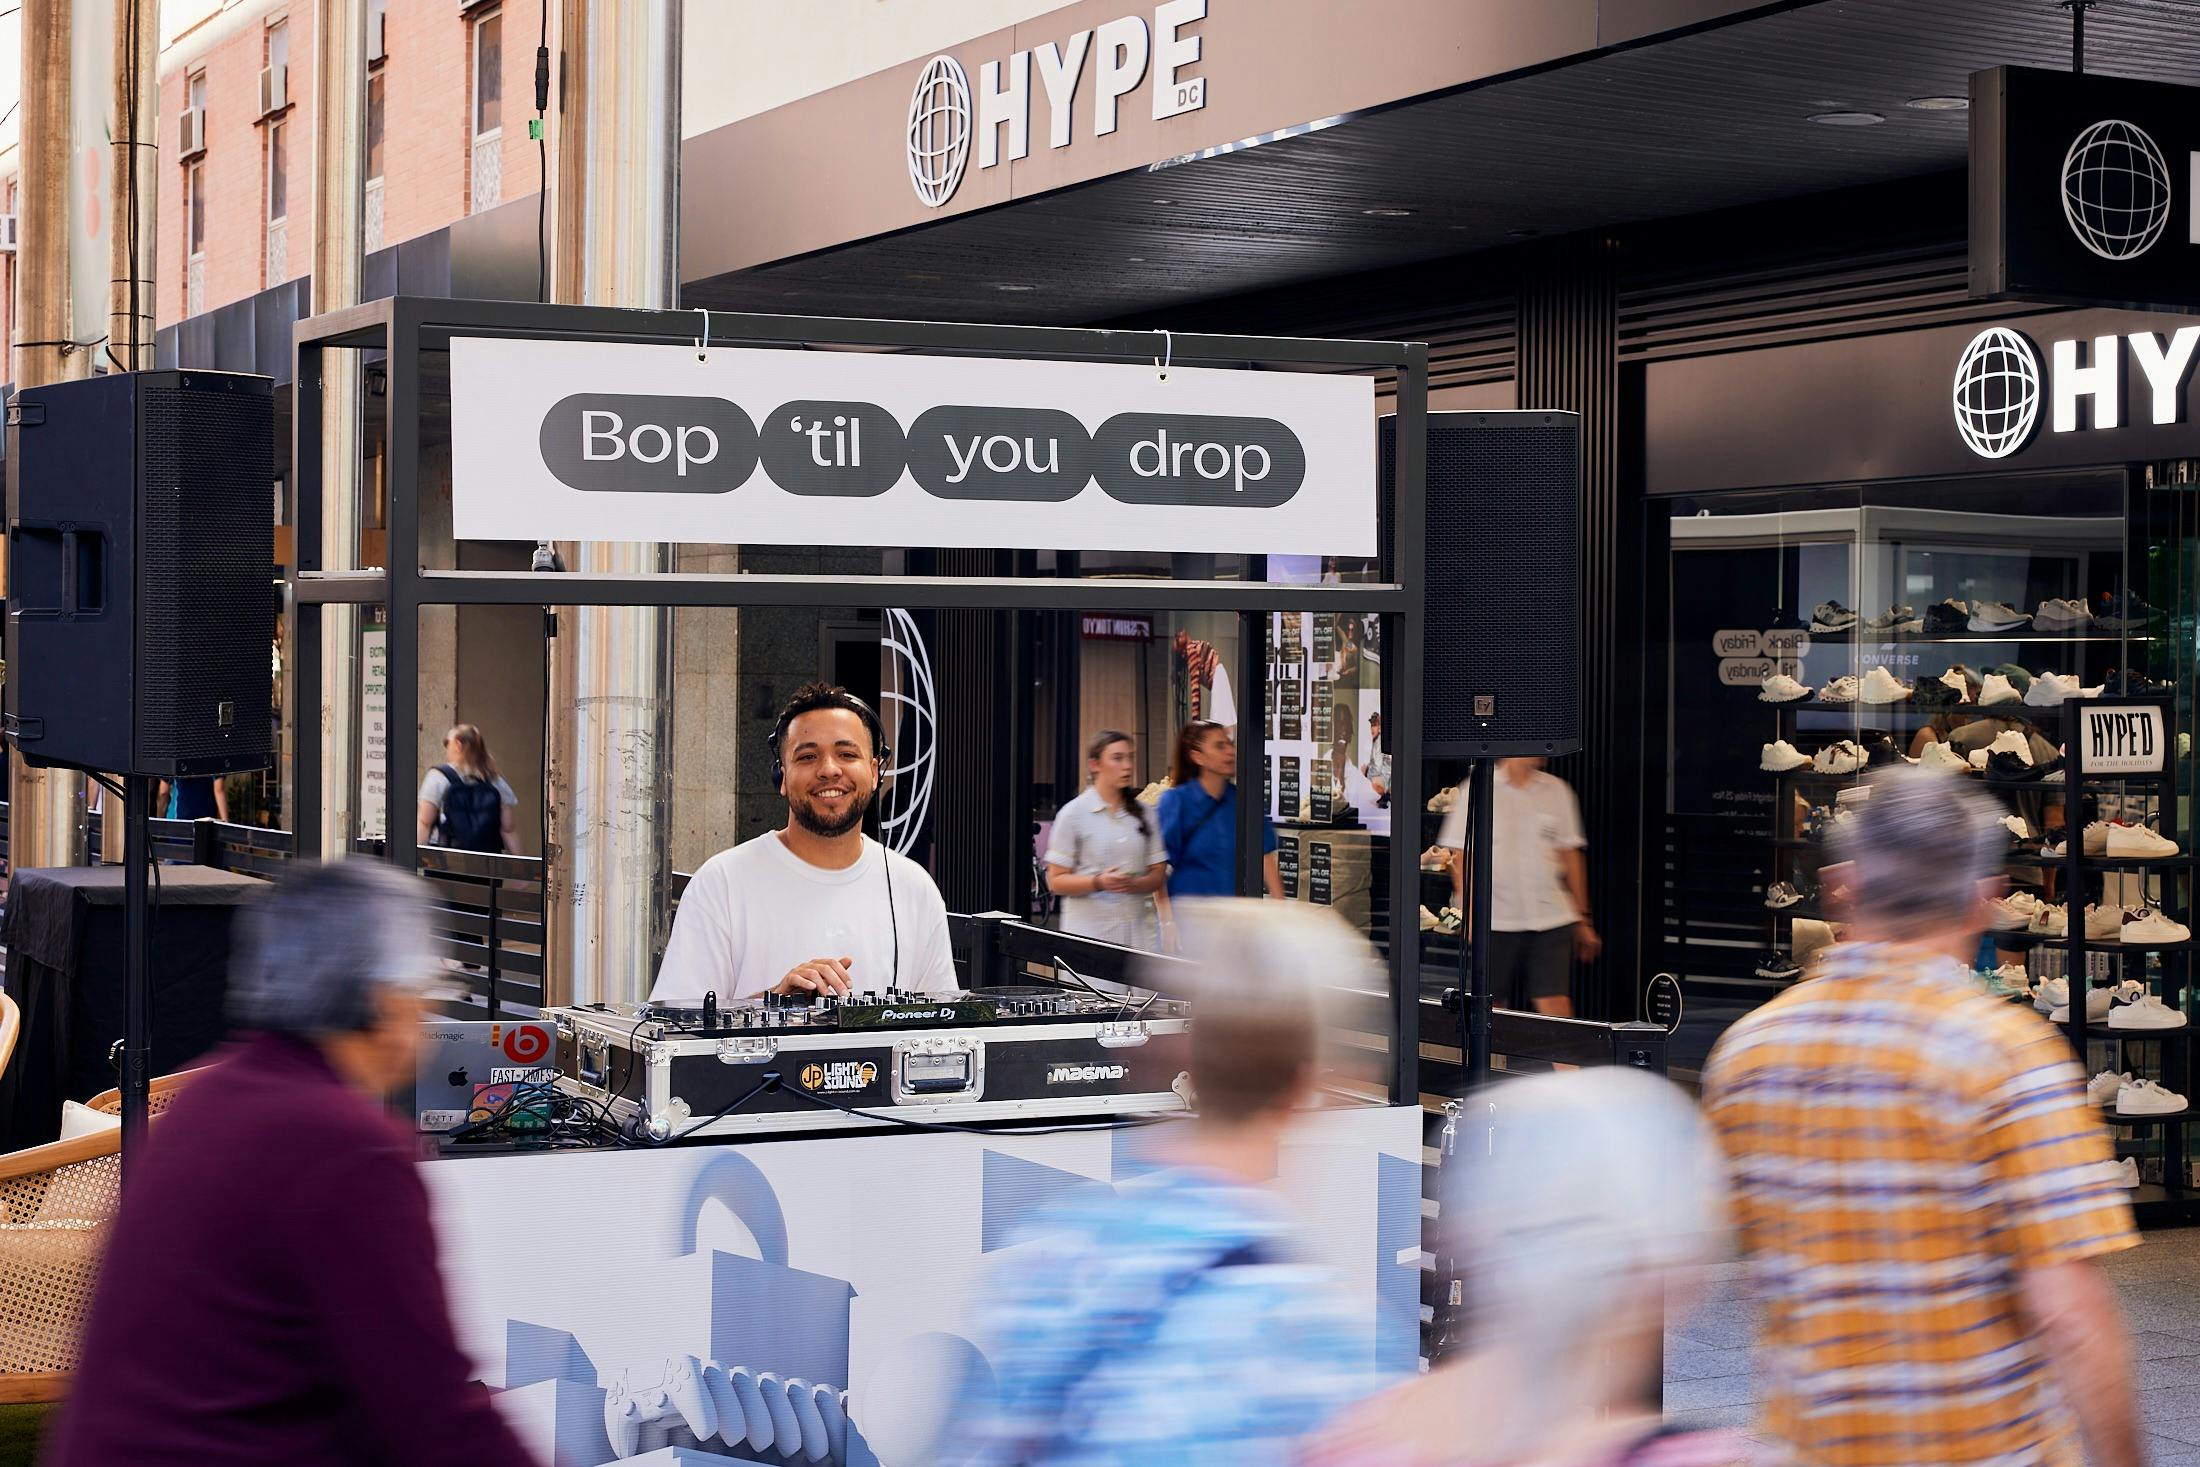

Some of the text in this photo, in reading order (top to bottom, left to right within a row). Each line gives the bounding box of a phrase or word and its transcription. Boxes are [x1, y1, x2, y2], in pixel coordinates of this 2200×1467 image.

[979, 0, 1207, 169] HYPE
[1177, 85, 1199, 107] DC
[582, 410, 720, 476] Bop
[943, 434, 1059, 484] you
[1129, 429, 1271, 492] drop
[1854, 654, 1920, 666] CONVERSE
[881, 1009, 938, 1021] Pioneer
[803, 1065, 822, 1089] JP
[823, 1062, 859, 1076] LIGHT
[823, 1072, 867, 1090] SOUND
